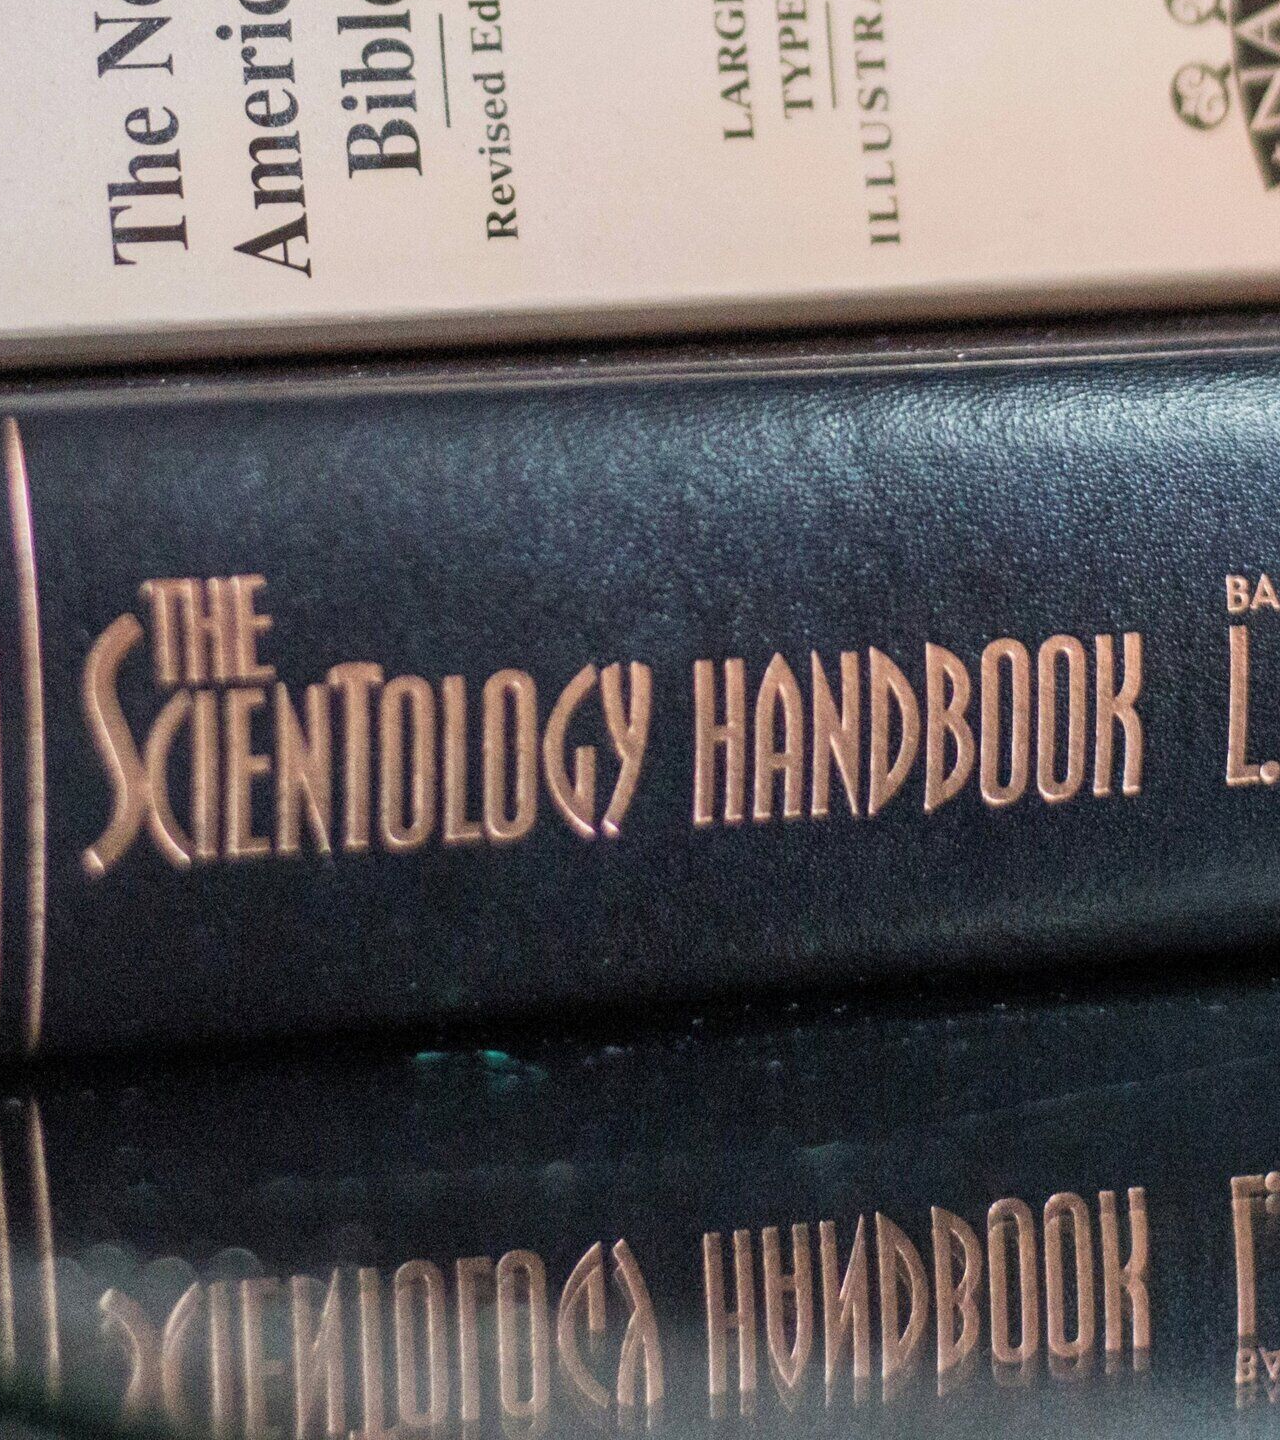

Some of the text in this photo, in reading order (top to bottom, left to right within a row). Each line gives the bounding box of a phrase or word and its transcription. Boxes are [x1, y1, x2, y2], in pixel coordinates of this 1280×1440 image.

[107, 103, 190, 267] The
[474, 68, 520, 242] Revised
[140, 573, 276, 686] THE
[81, 612, 1144, 876] SCIENTOLOGY HANDBOOK
